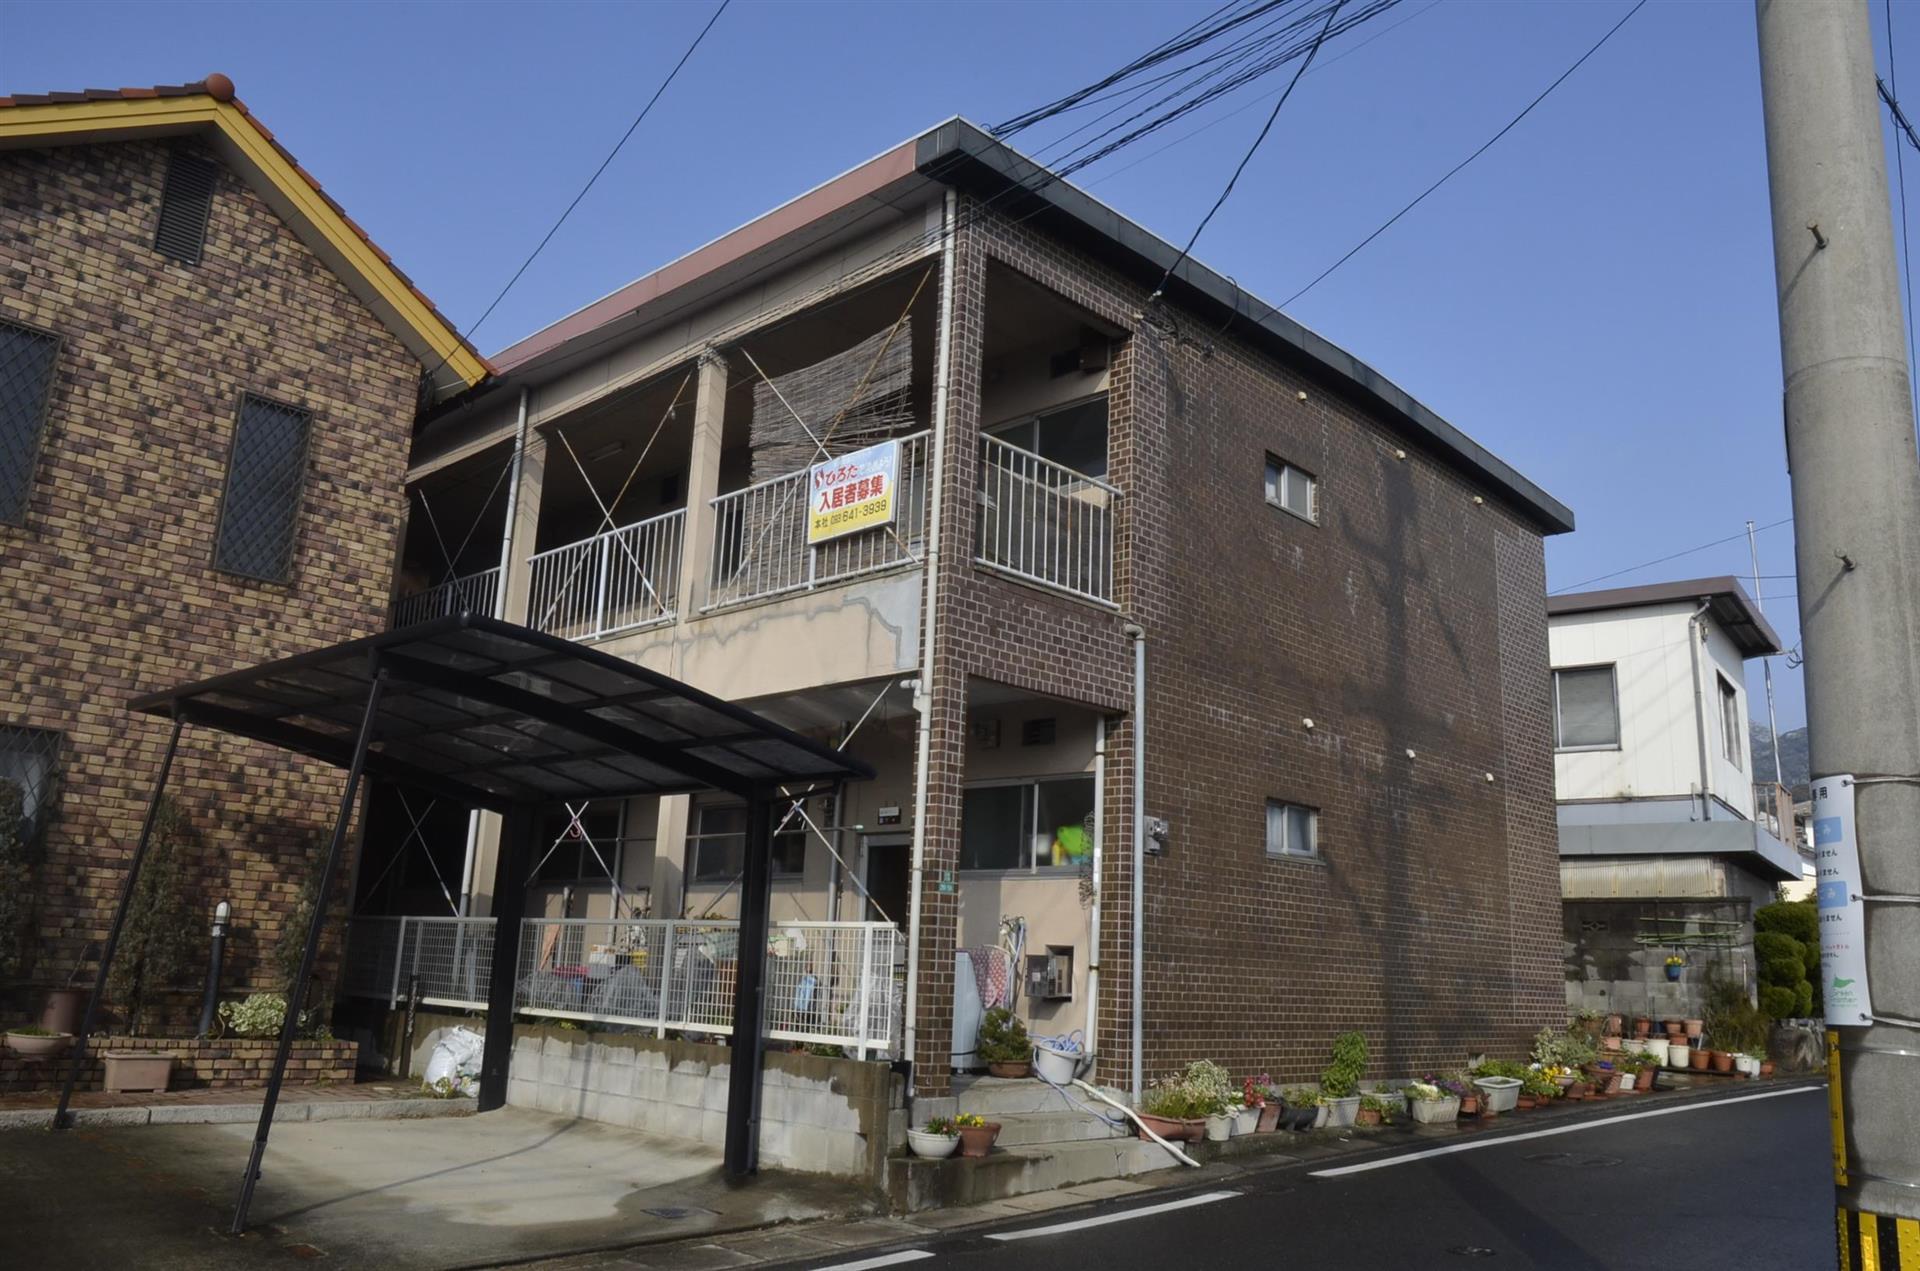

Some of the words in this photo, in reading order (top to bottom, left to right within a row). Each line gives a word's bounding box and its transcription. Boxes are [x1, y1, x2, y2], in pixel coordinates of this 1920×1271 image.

[826, 464, 858, 486] ひろた
[819, 474, 884, 512] 入居者募集
